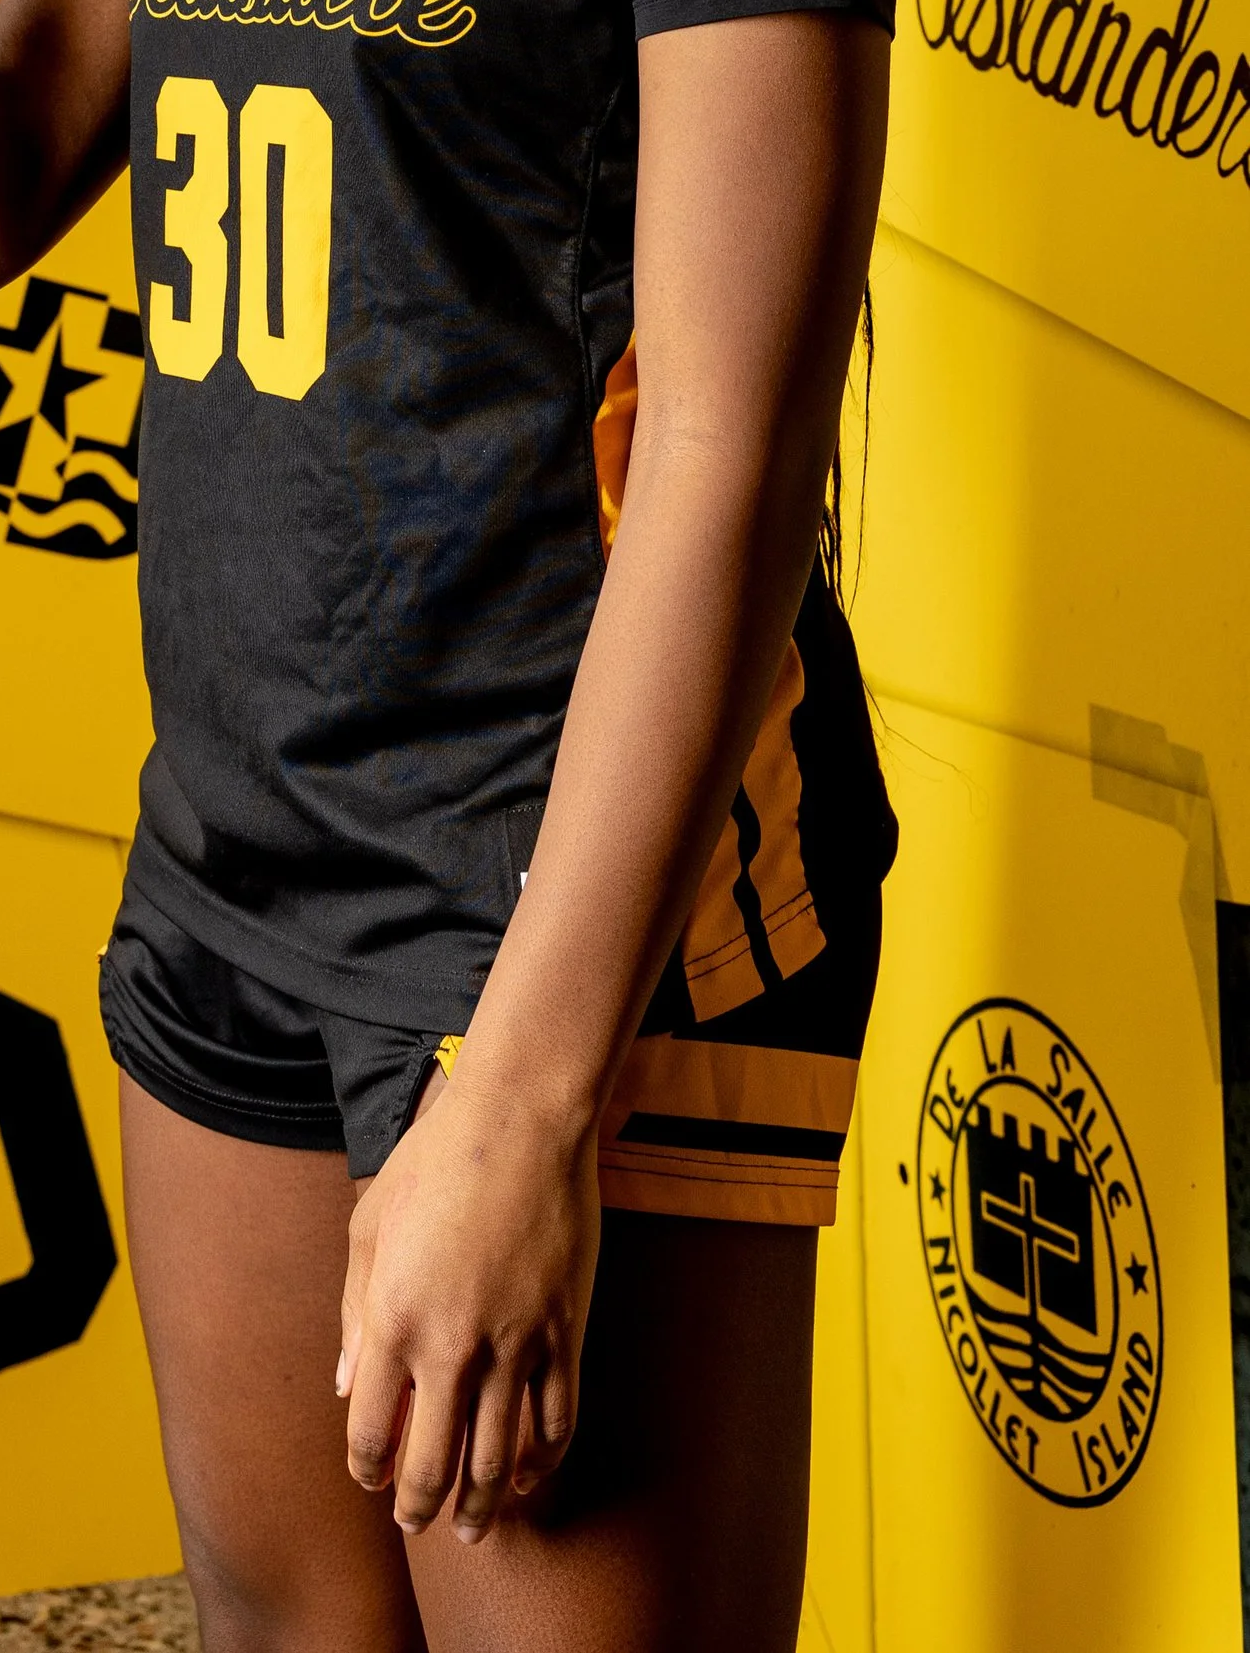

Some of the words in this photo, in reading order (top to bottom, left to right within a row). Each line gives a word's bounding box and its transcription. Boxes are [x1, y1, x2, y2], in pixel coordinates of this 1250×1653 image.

[149, 76, 333, 401] 30
[927, 1068, 965, 1145] DE
[977, 1019, 1016, 1075] LA
[1046, 1043, 1132, 1218] SALLE
[927, 1237, 1040, 1473] NICOLLET
[1073, 1331, 1154, 1493] ISLAND
